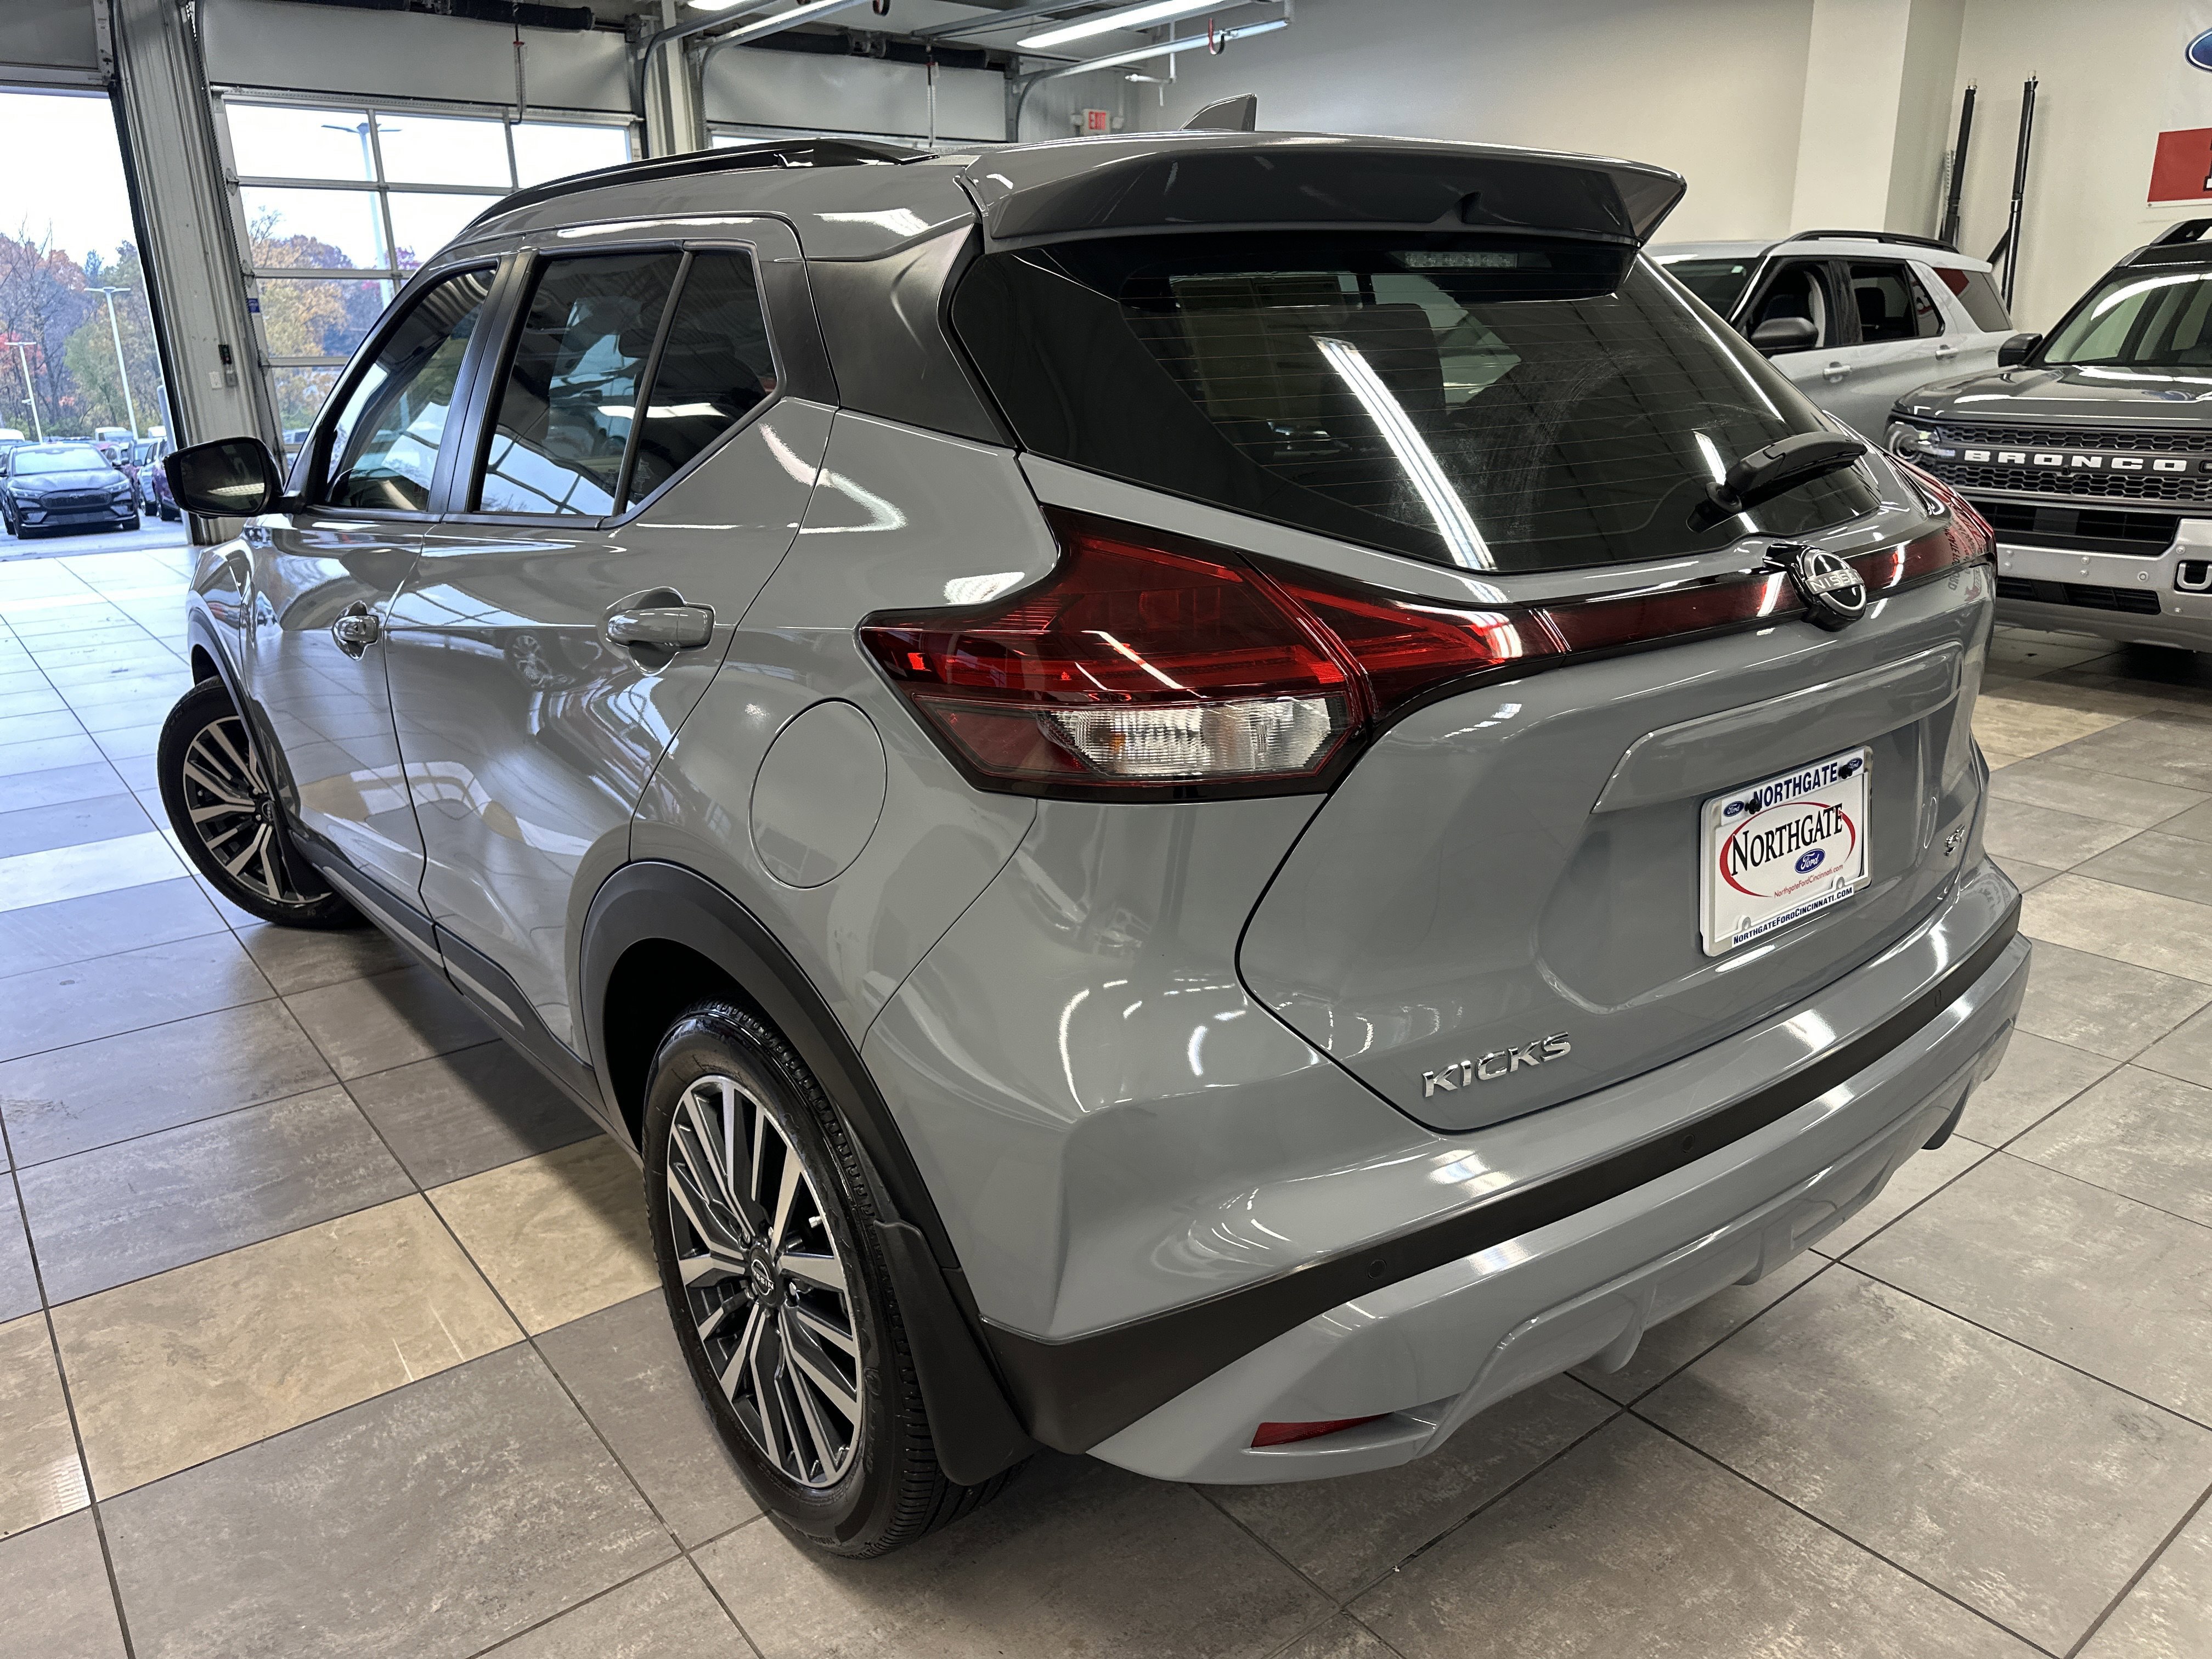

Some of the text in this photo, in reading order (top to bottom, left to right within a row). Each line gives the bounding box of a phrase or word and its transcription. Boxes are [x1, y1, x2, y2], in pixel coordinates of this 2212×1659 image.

[1963, 449, 2187, 472] BRONCO
[1753, 761, 1838, 809] NORTHGATE
[1731, 803, 1843, 877] NORTHGATE
[1774, 864, 1844, 899] NorthgateFordCincinnati.com
[1800, 852, 1820, 870] Ford
[1422, 1031, 1571, 1098] KICKS
